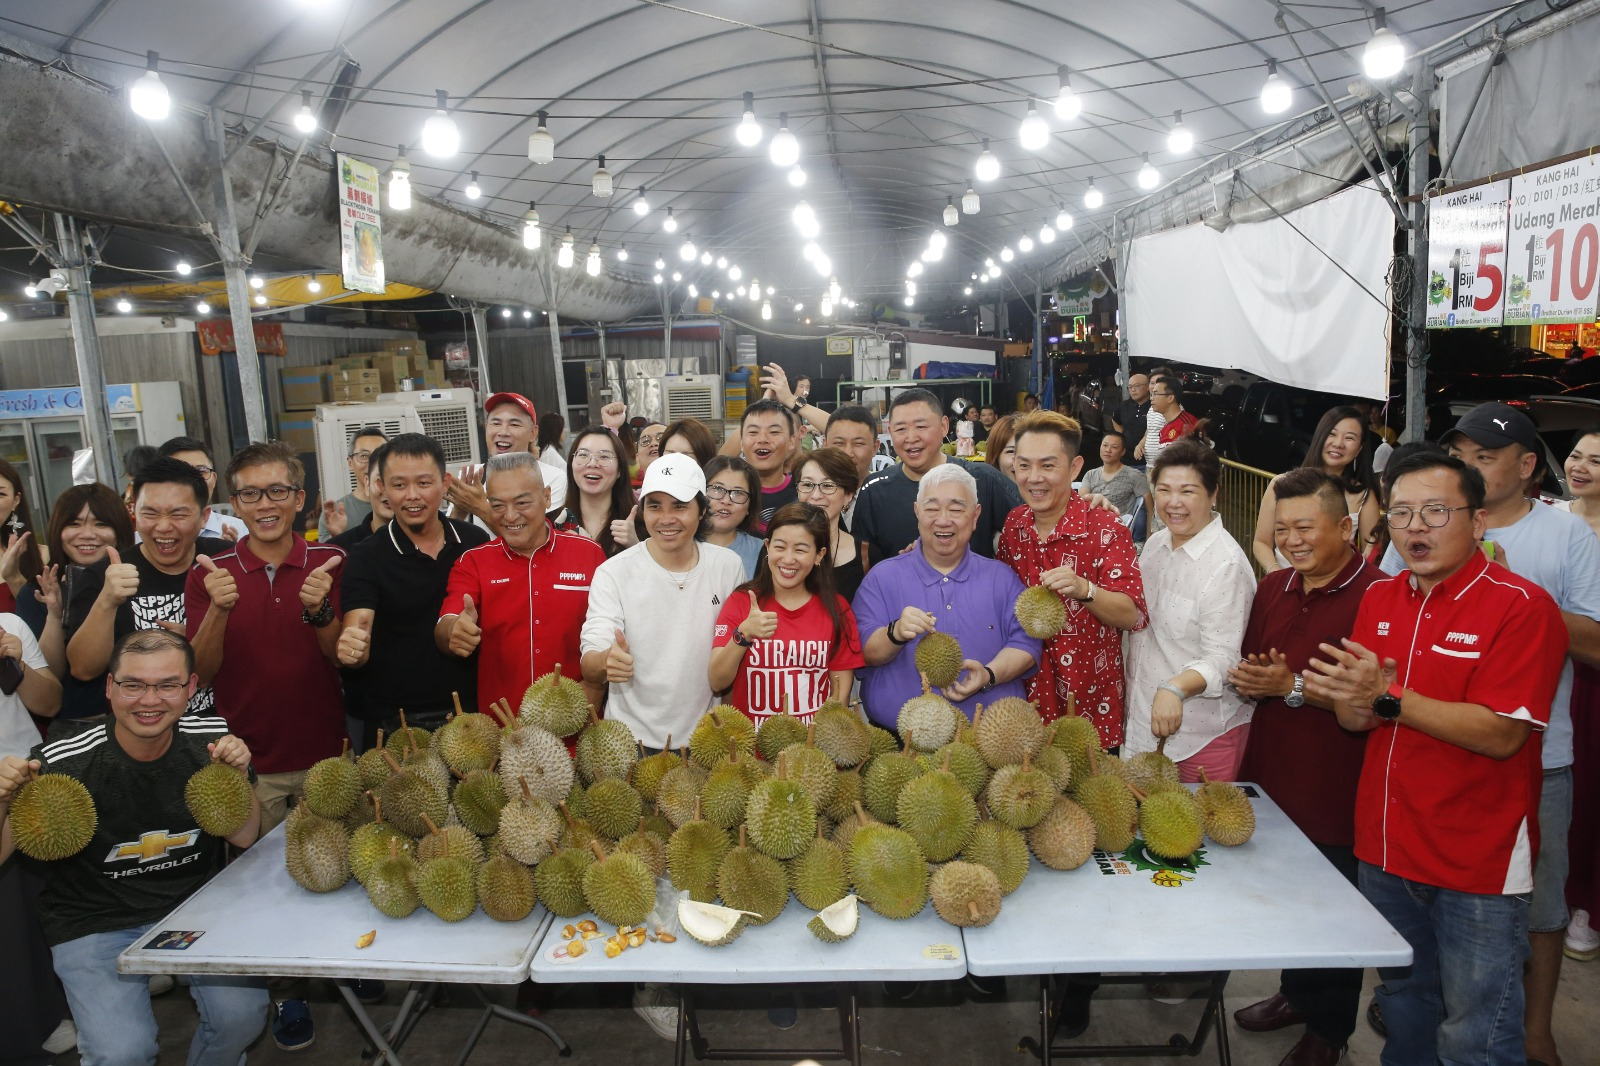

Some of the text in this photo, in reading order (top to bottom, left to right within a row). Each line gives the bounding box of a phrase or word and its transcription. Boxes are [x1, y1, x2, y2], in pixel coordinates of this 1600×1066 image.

[1536, 166, 1579, 186] KANG HAI
[1447, 191, 1482, 207] KANG HAI
[1515, 195, 1526, 206] XO
[1533, 189, 1553, 202] D101
[1562, 183, 1579, 196] D13
[1514, 211, 1555, 230] Udang
[1525, 234, 1535, 282] 1
[1534, 254, 1546, 267] Biji
[1546, 223, 1599, 302] 10
[1449, 248, 1461, 310] 1
[1460, 272, 1474, 288] Biji
[1473, 243, 1503, 312] 5
[1533, 270, 1545, 281] RM
[1061, 306, 1089, 314] DURIAN
[1459, 295, 1473, 308] RM
[1377, 622, 1390, 630] KEN
[750, 639, 831, 668] STRAIGH
[103, 852, 202, 879] CHEVROLET
